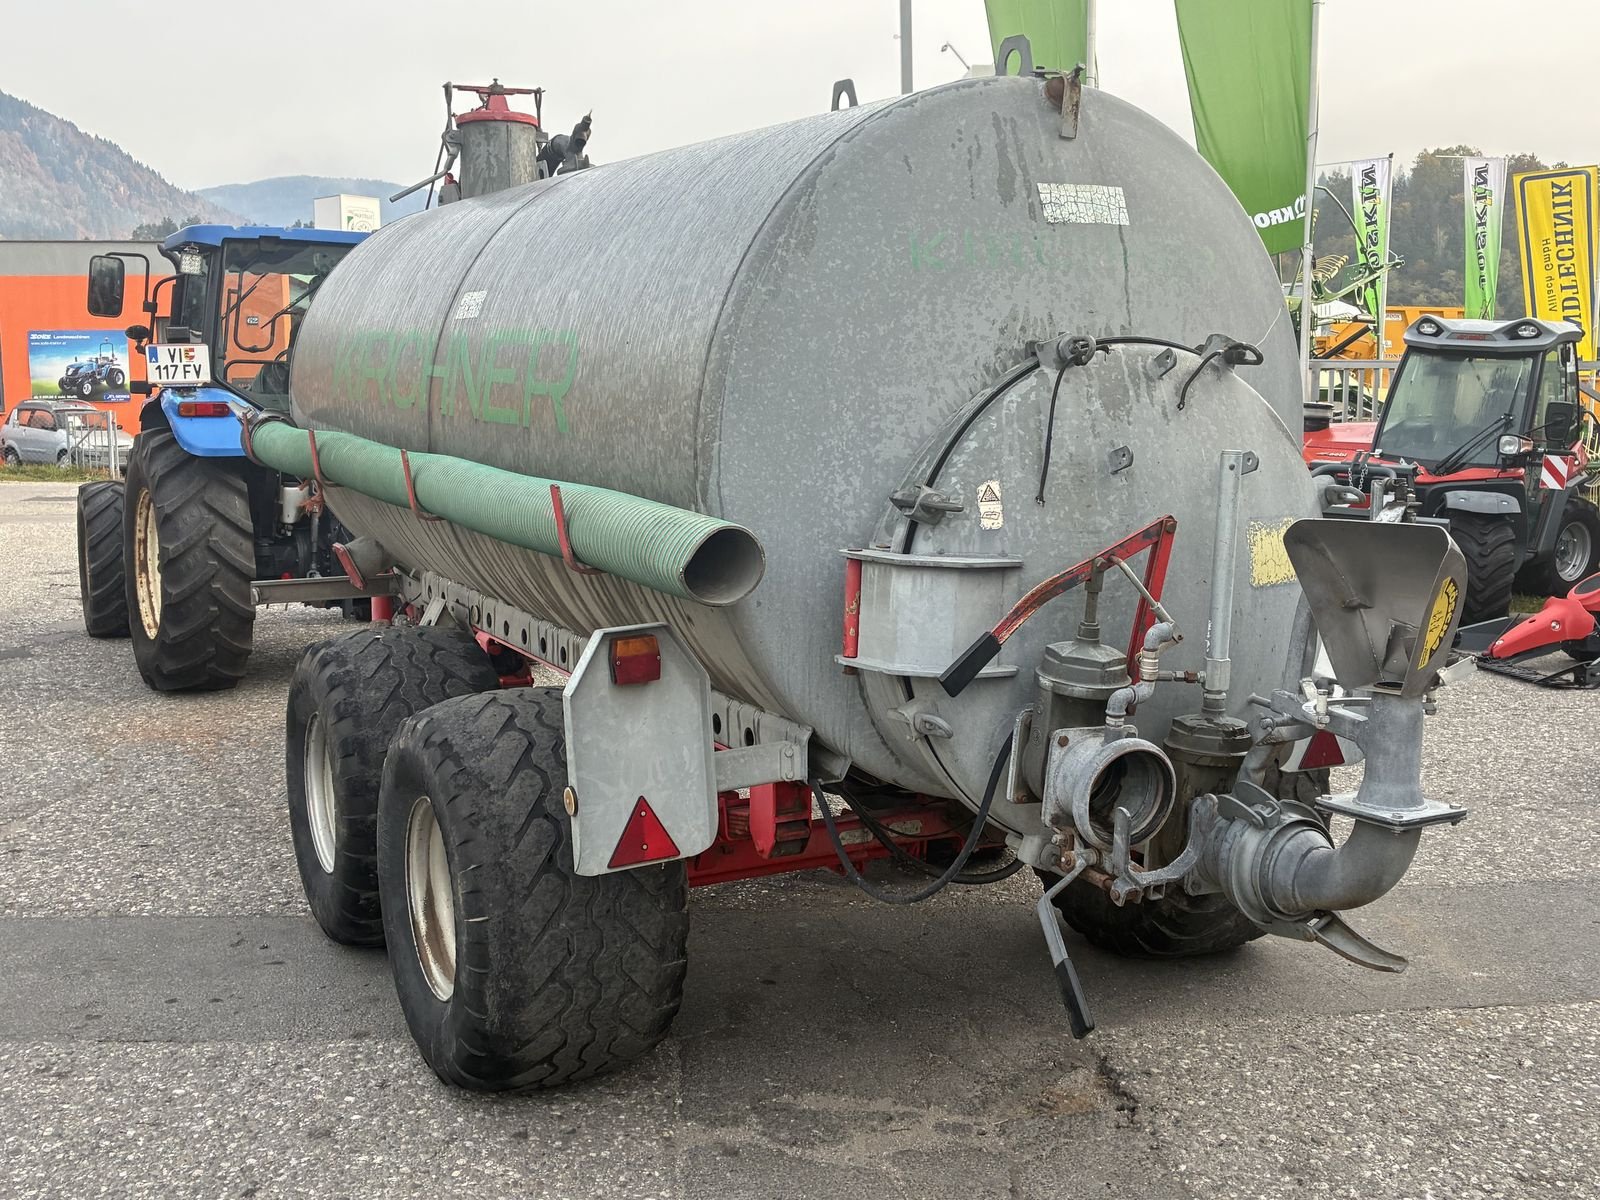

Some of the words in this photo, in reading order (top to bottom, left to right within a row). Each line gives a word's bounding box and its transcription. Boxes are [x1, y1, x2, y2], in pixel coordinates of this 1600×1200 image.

[167, 347, 182, 363] VI
[155, 364, 179, 380] 117
[183, 364, 201, 379] FV
[332, 326, 578, 433] KIRCHNER
